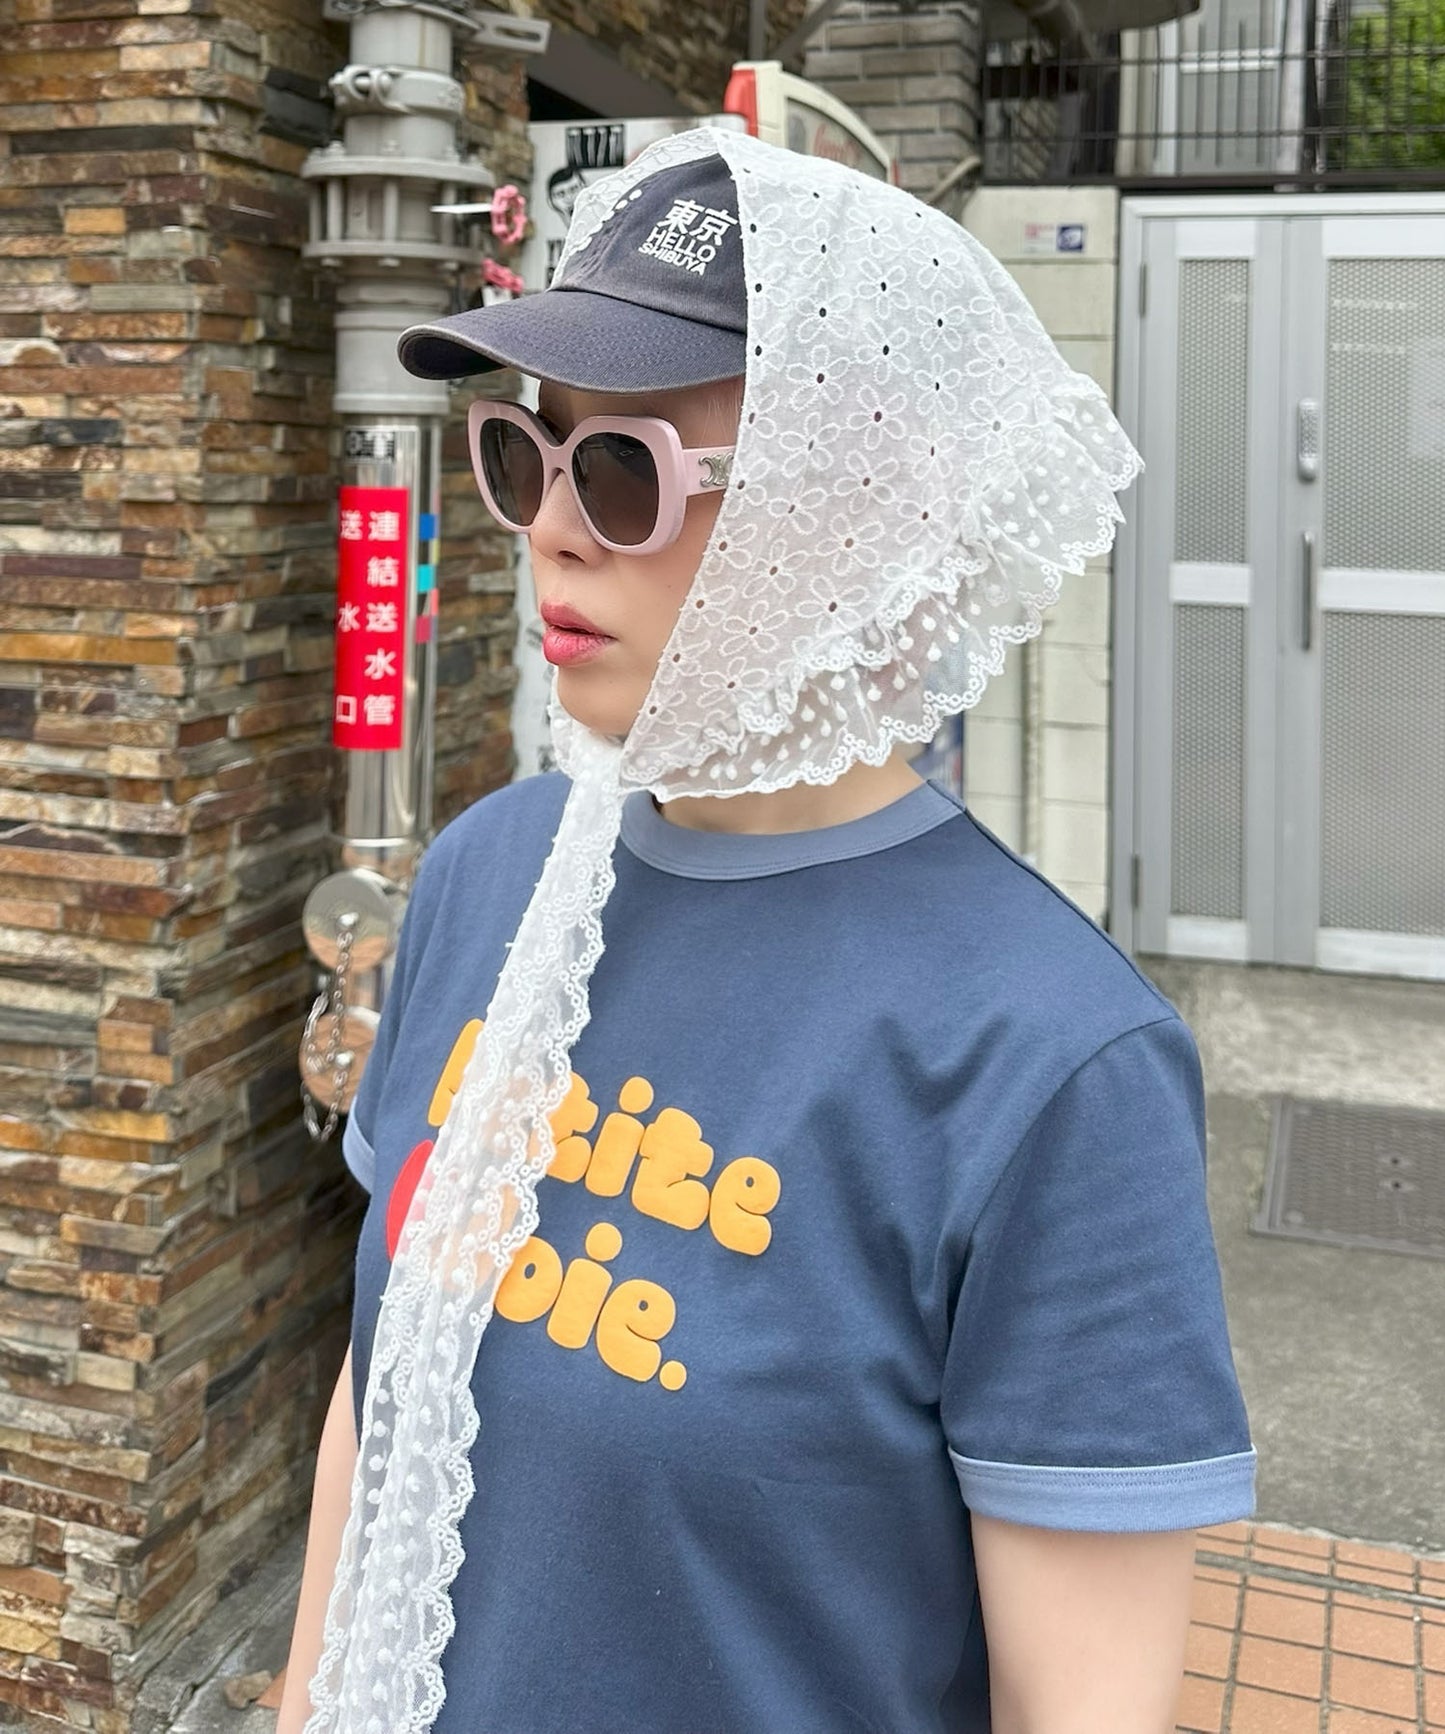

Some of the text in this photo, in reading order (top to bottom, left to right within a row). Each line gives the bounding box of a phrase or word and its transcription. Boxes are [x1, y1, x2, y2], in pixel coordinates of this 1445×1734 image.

[638, 242, 707, 276] SHIBUYA
[646, 226, 716, 263] HELLO
[656, 199, 739, 246] 東京
[335, 509, 363, 725] 送水口
[363, 510, 400, 726] 連結送水管
[427, 1018, 781, 1256] tite
